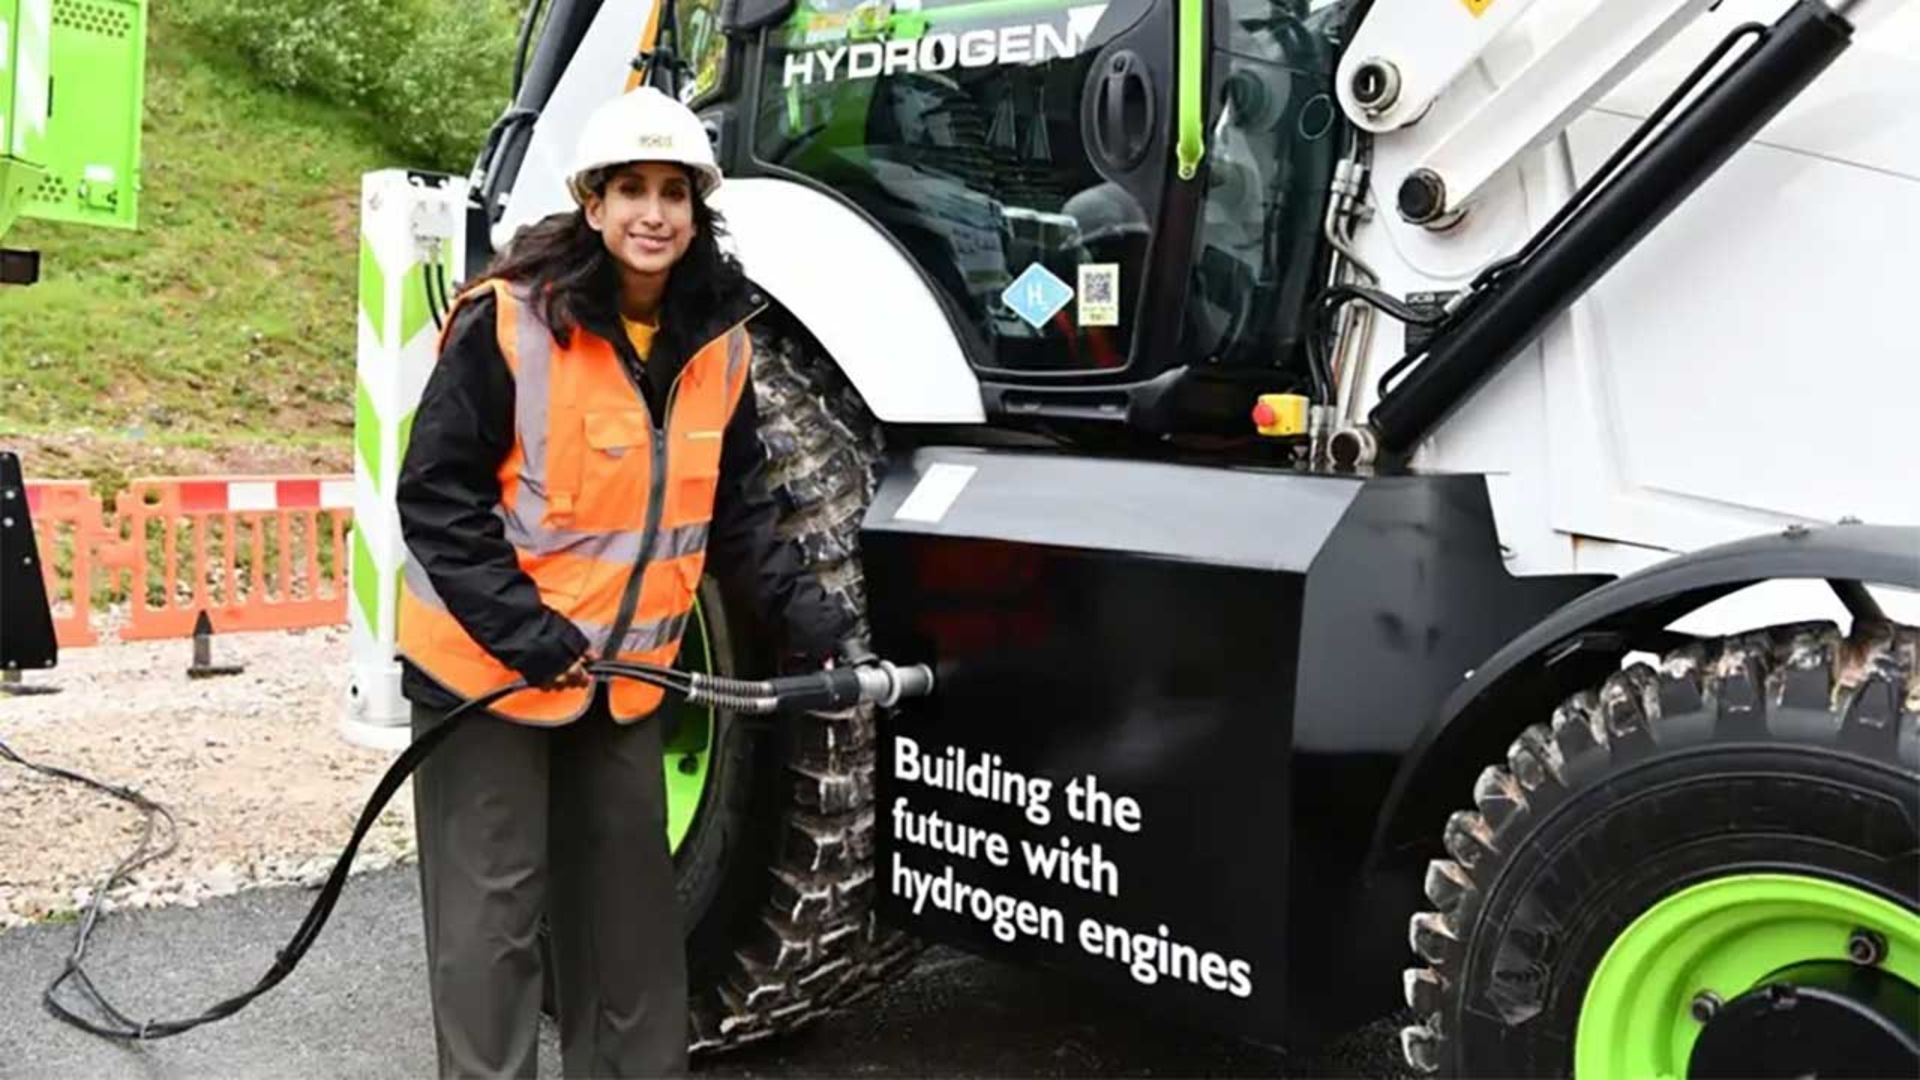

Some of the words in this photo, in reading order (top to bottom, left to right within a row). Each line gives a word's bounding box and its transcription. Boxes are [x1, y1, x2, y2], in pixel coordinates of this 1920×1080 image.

[783, 23, 1084, 88] HYDROGEN
[893, 735, 1053, 826] Building
[1064, 774, 1142, 833] the
[892, 797, 1010, 867] future
[1020, 835, 1119, 897] with
[892, 852, 1064, 943] hydrogen
[1078, 917, 1252, 998] engines
